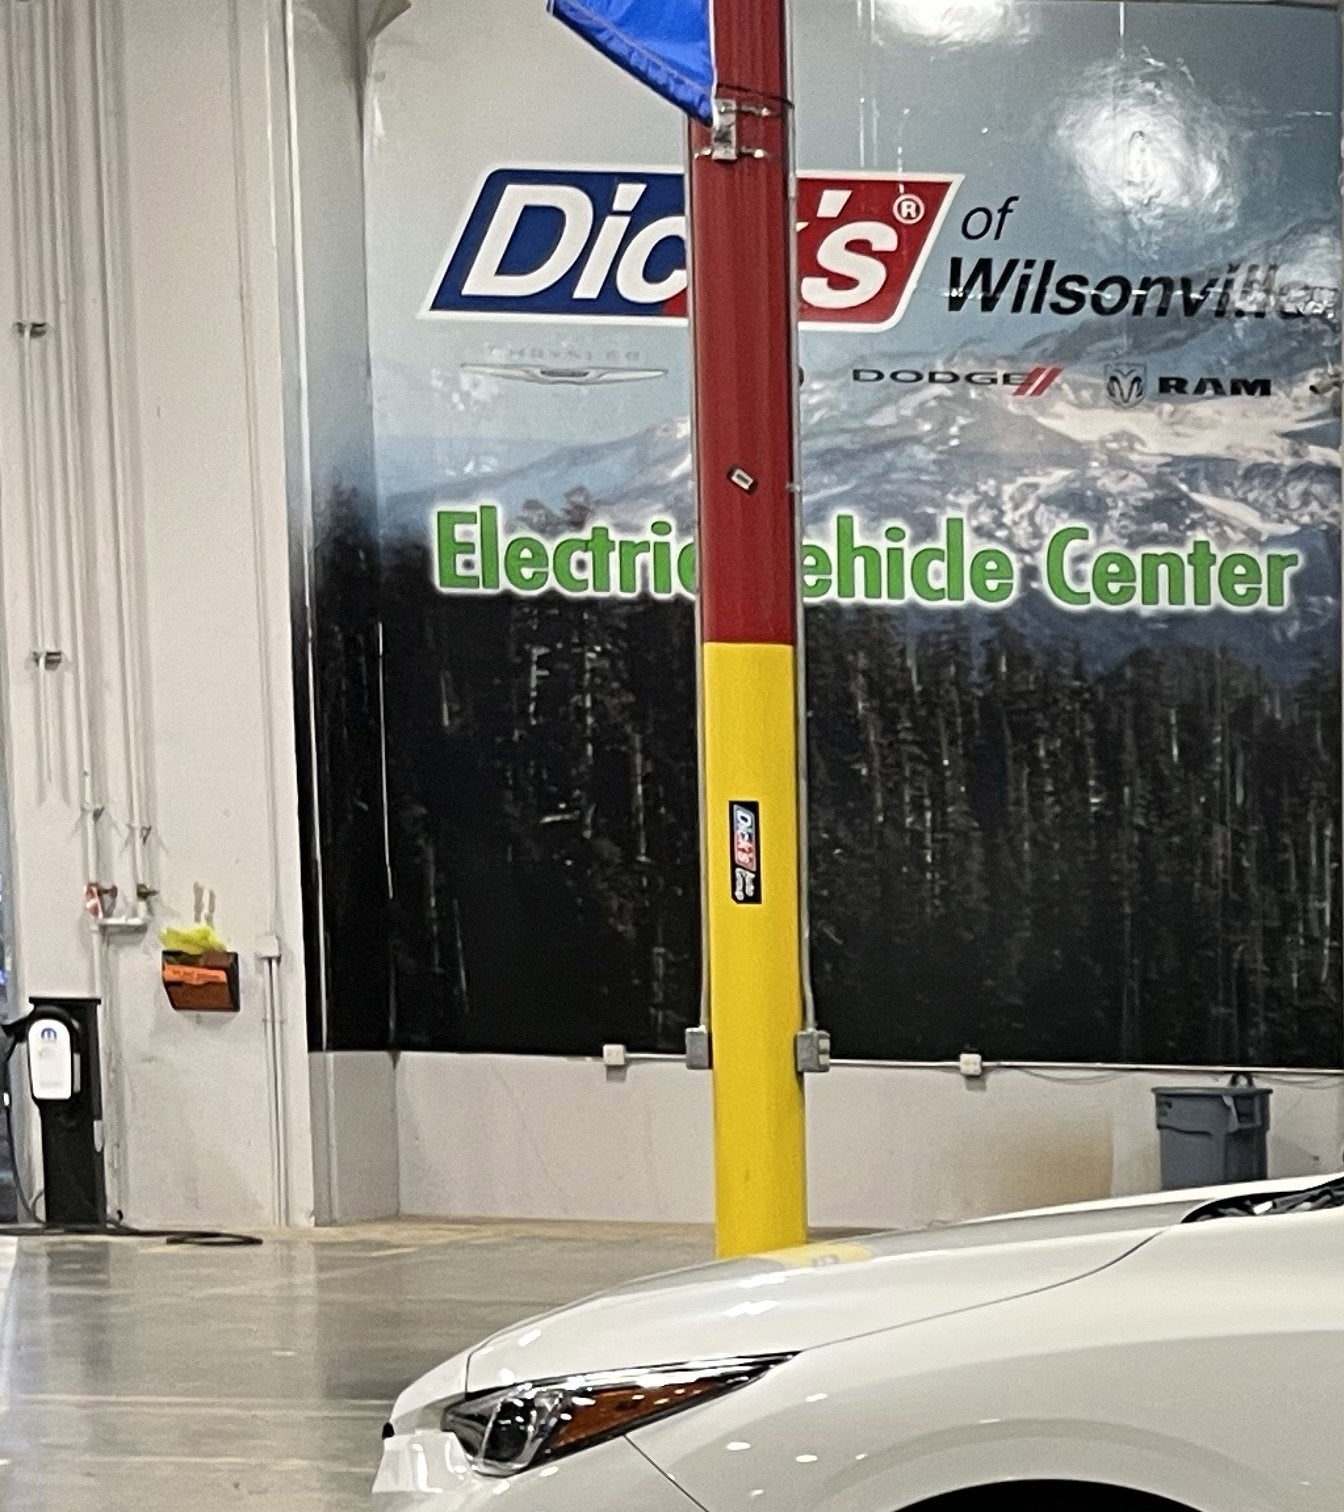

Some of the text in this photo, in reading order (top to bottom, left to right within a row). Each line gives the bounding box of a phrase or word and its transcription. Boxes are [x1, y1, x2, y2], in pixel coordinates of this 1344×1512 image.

[961, 195, 1020, 241] of
[461, 181, 899, 309] Dic's
[852, 368, 1036, 386] DODGE
[1158, 376, 1272, 397] RAM
[801, 514, 1014, 602] ehicle
[1046, 526, 1299, 607] Center
